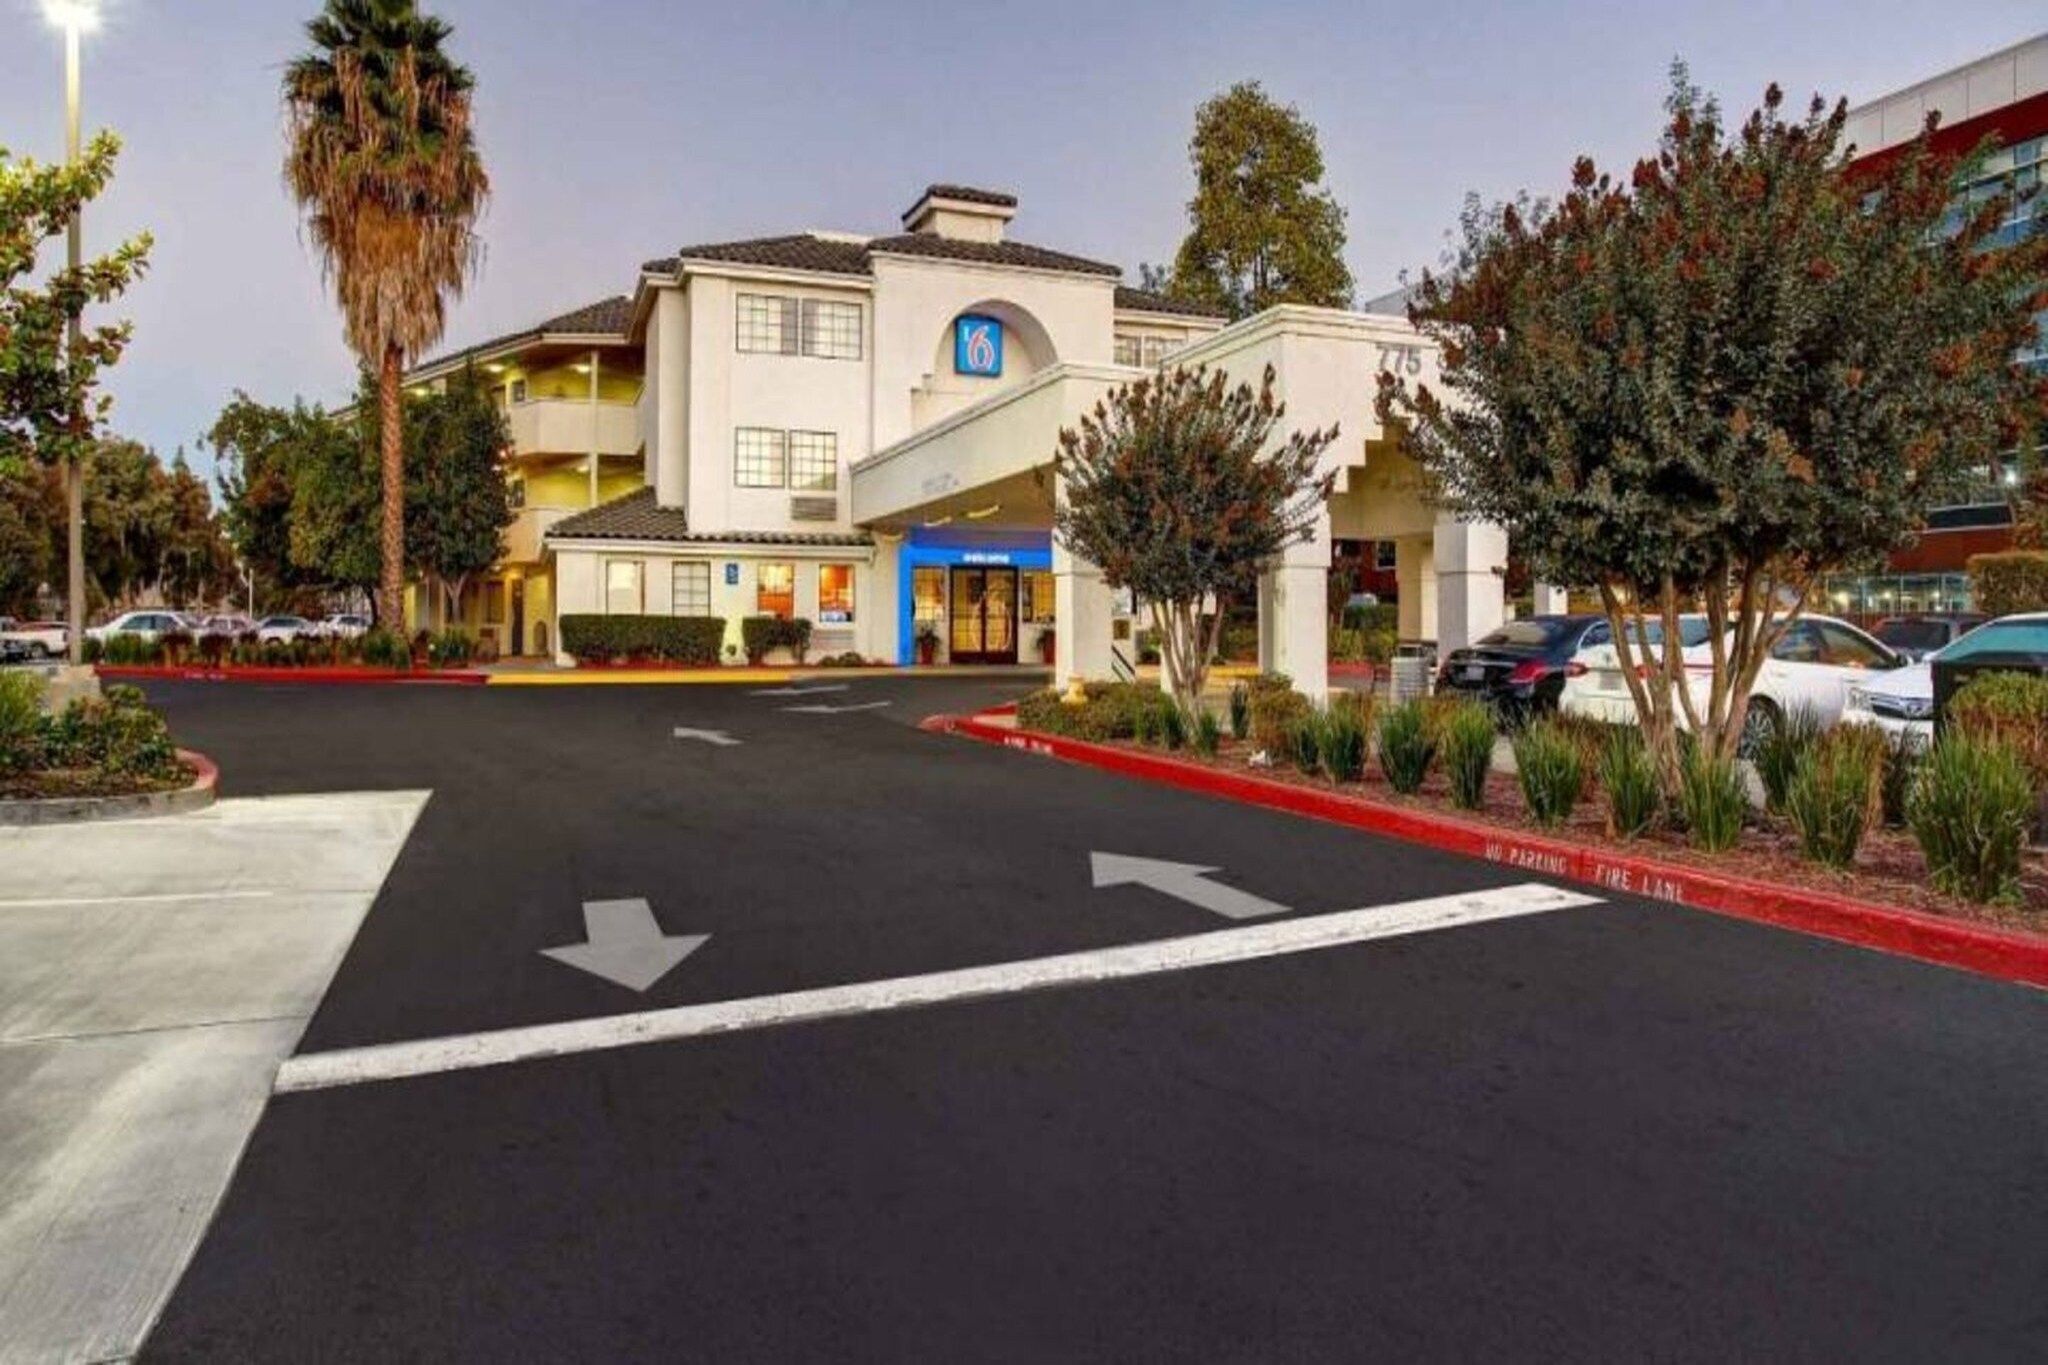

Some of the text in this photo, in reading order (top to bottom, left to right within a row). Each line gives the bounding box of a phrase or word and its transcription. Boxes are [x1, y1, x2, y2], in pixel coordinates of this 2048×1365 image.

[968, 325, 995, 371] 6
[1376, 342, 1421, 376] 775
[1509, 847, 1568, 875] PARKING
[1595, 863, 1633, 892] FIRE
